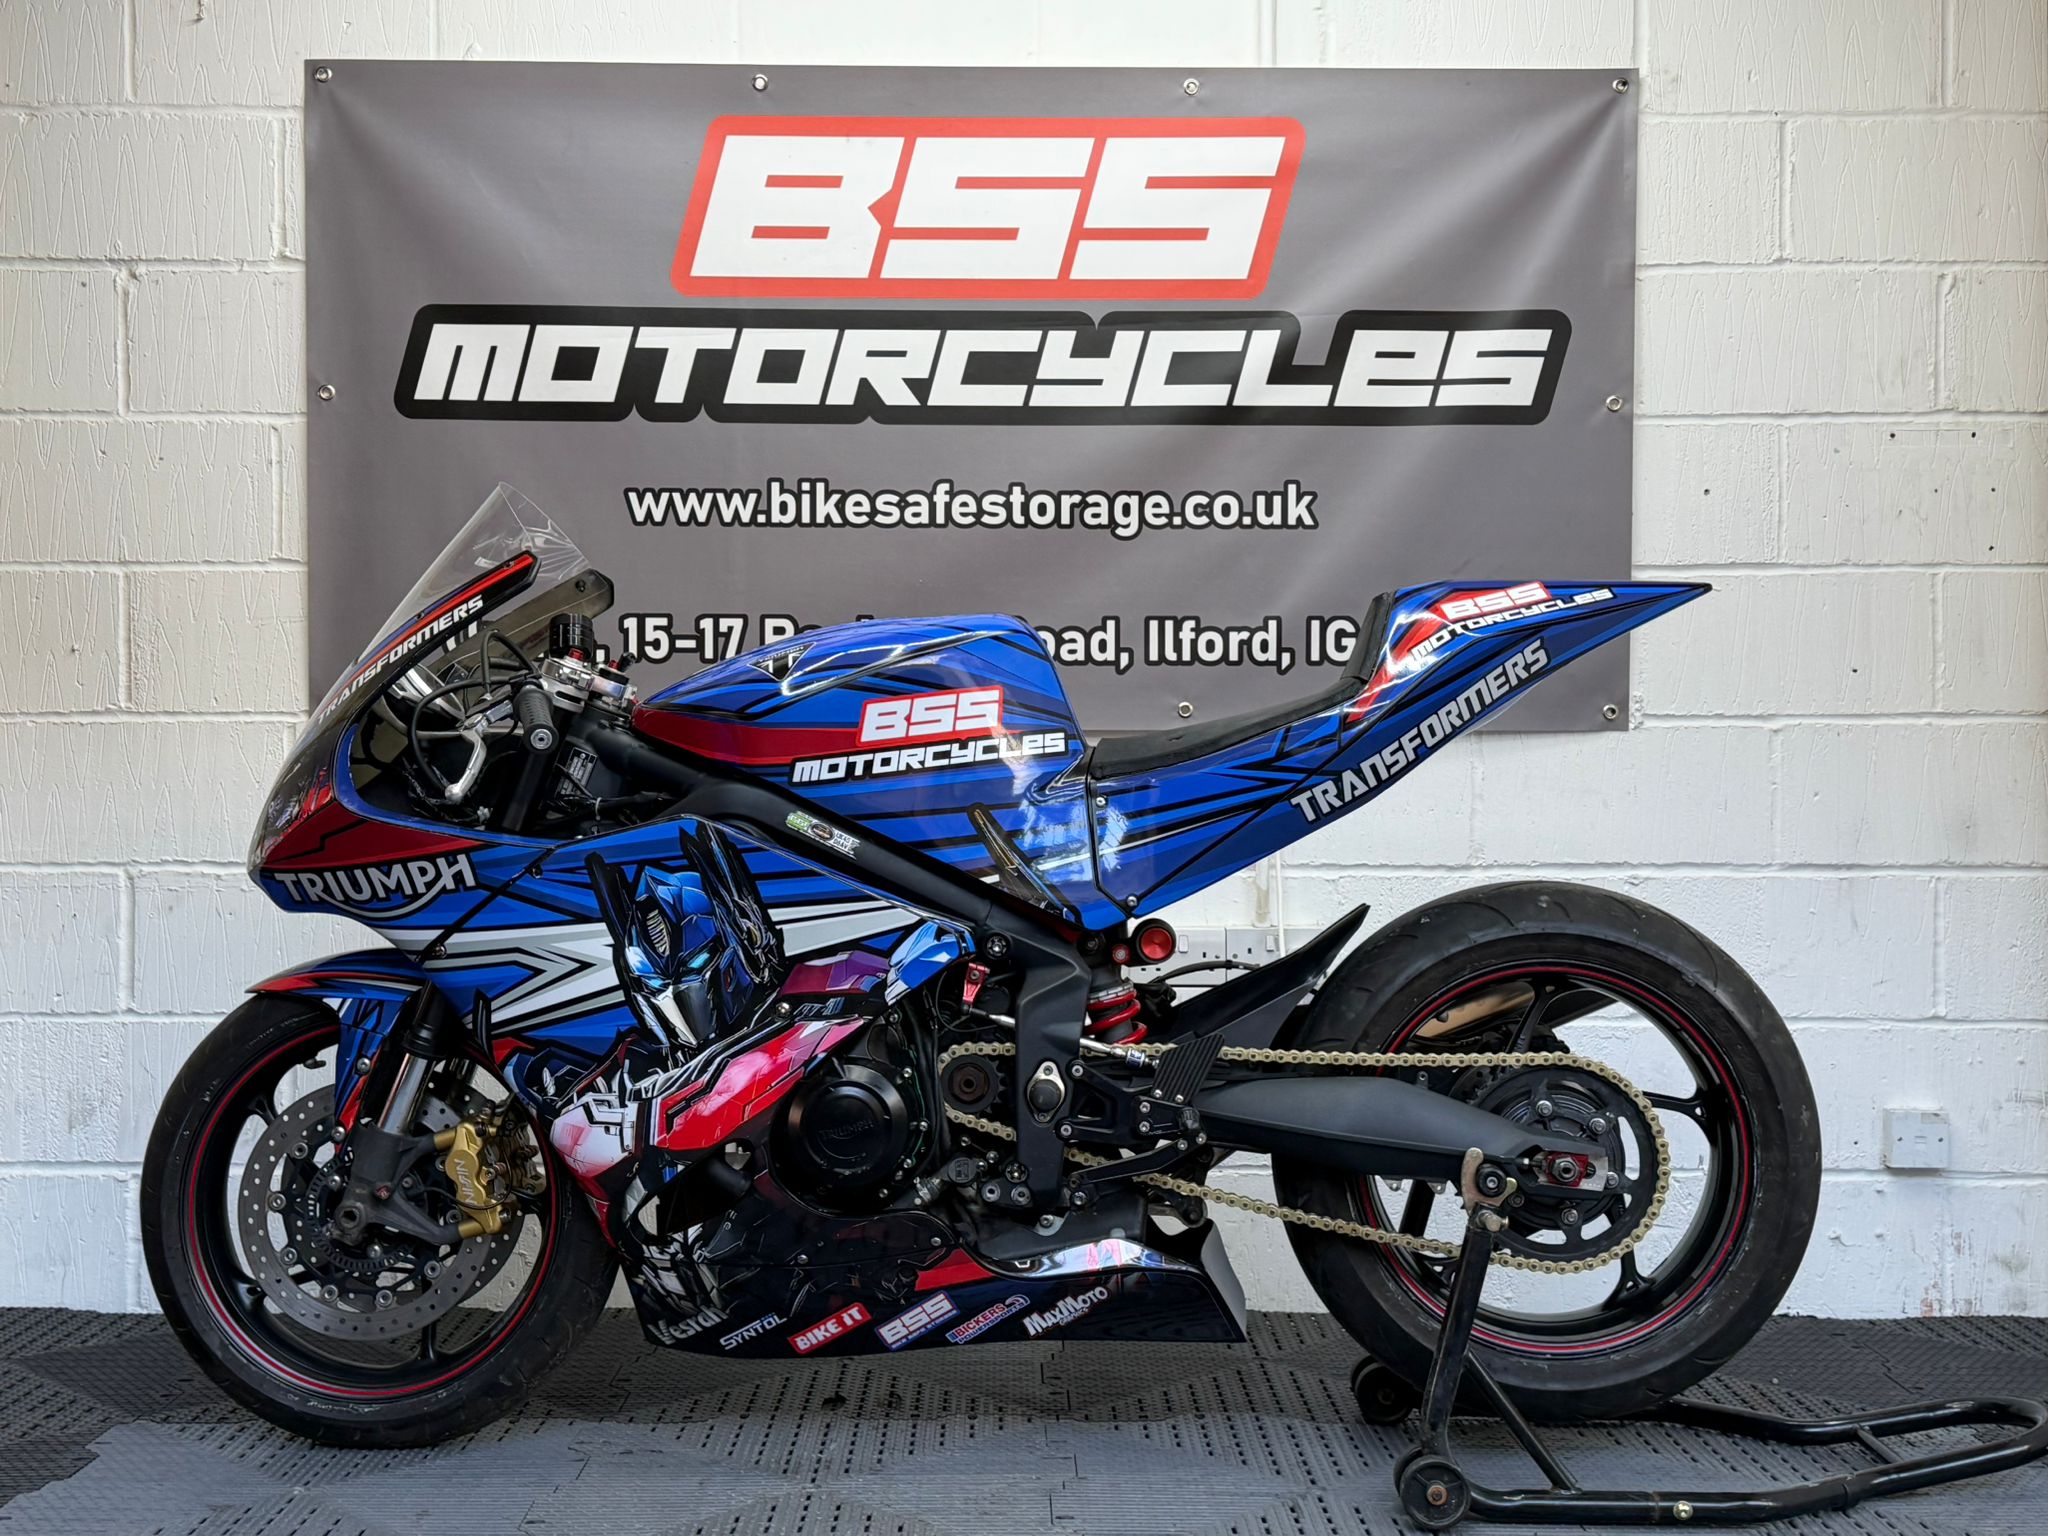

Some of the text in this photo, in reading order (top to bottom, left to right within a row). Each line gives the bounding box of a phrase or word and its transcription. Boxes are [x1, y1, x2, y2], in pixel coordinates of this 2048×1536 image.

[690, 134, 1286, 279] BSS
[627, 482, 1316, 533] www.bikesafestorage.co.uk
[1440, 582, 1548, 620] BSS
[317, 595, 484, 724] TRANSFORMERS
[622, 617, 743, 660] 15-17
[1037, 619, 1130, 670] oad,
[1149, 619, 1291, 670] Ilford,
[861, 688, 1003, 743] BSS
[1290, 639, 1551, 823] TRANSFORMERS
[274, 853, 477, 904] TRIUMPH
[648, 1305, 729, 1345] Vesrah
[796, 1306, 865, 1351] BIKE IT
[879, 1293, 954, 1345] BSS
[955, 1303, 1008, 1338] BICKERS
